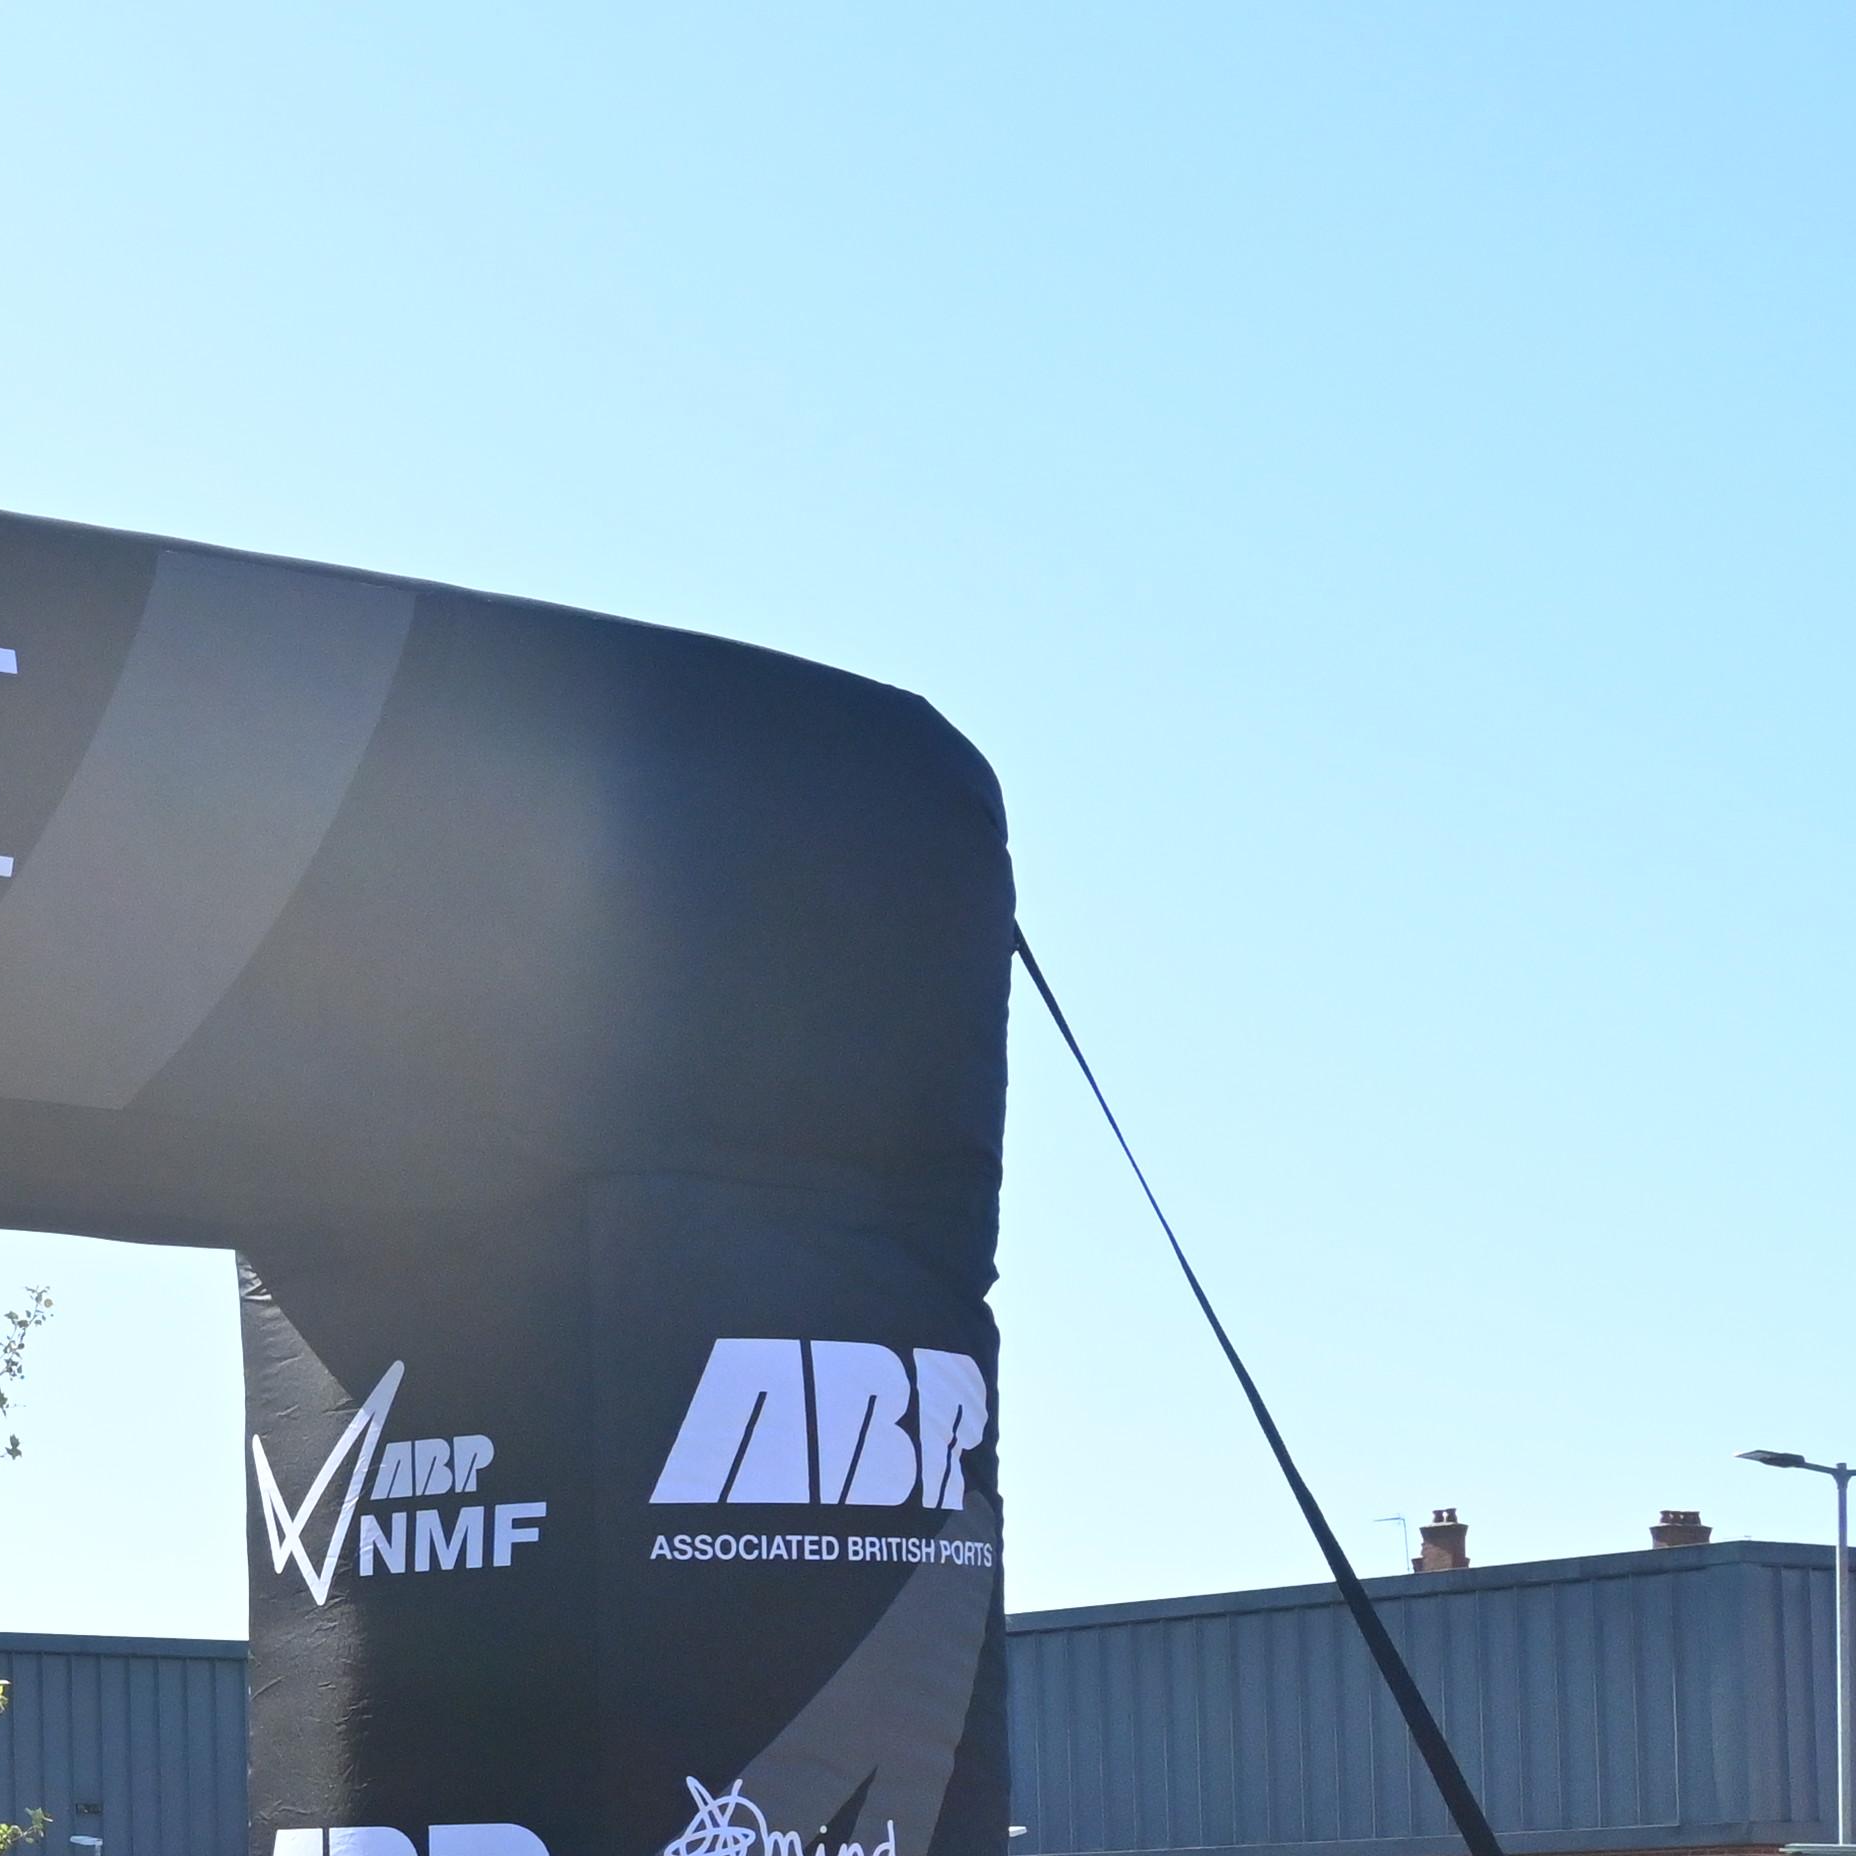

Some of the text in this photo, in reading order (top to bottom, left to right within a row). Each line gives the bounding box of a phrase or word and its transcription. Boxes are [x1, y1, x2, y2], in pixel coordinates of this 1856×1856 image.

[649, 1338, 988, 1511] ABP
[370, 1435, 495, 1500] ABP
[360, 1502, 547, 1577] NMF
[650, 1534, 993, 1568] ASSOCIATED BRITISH PORTS
